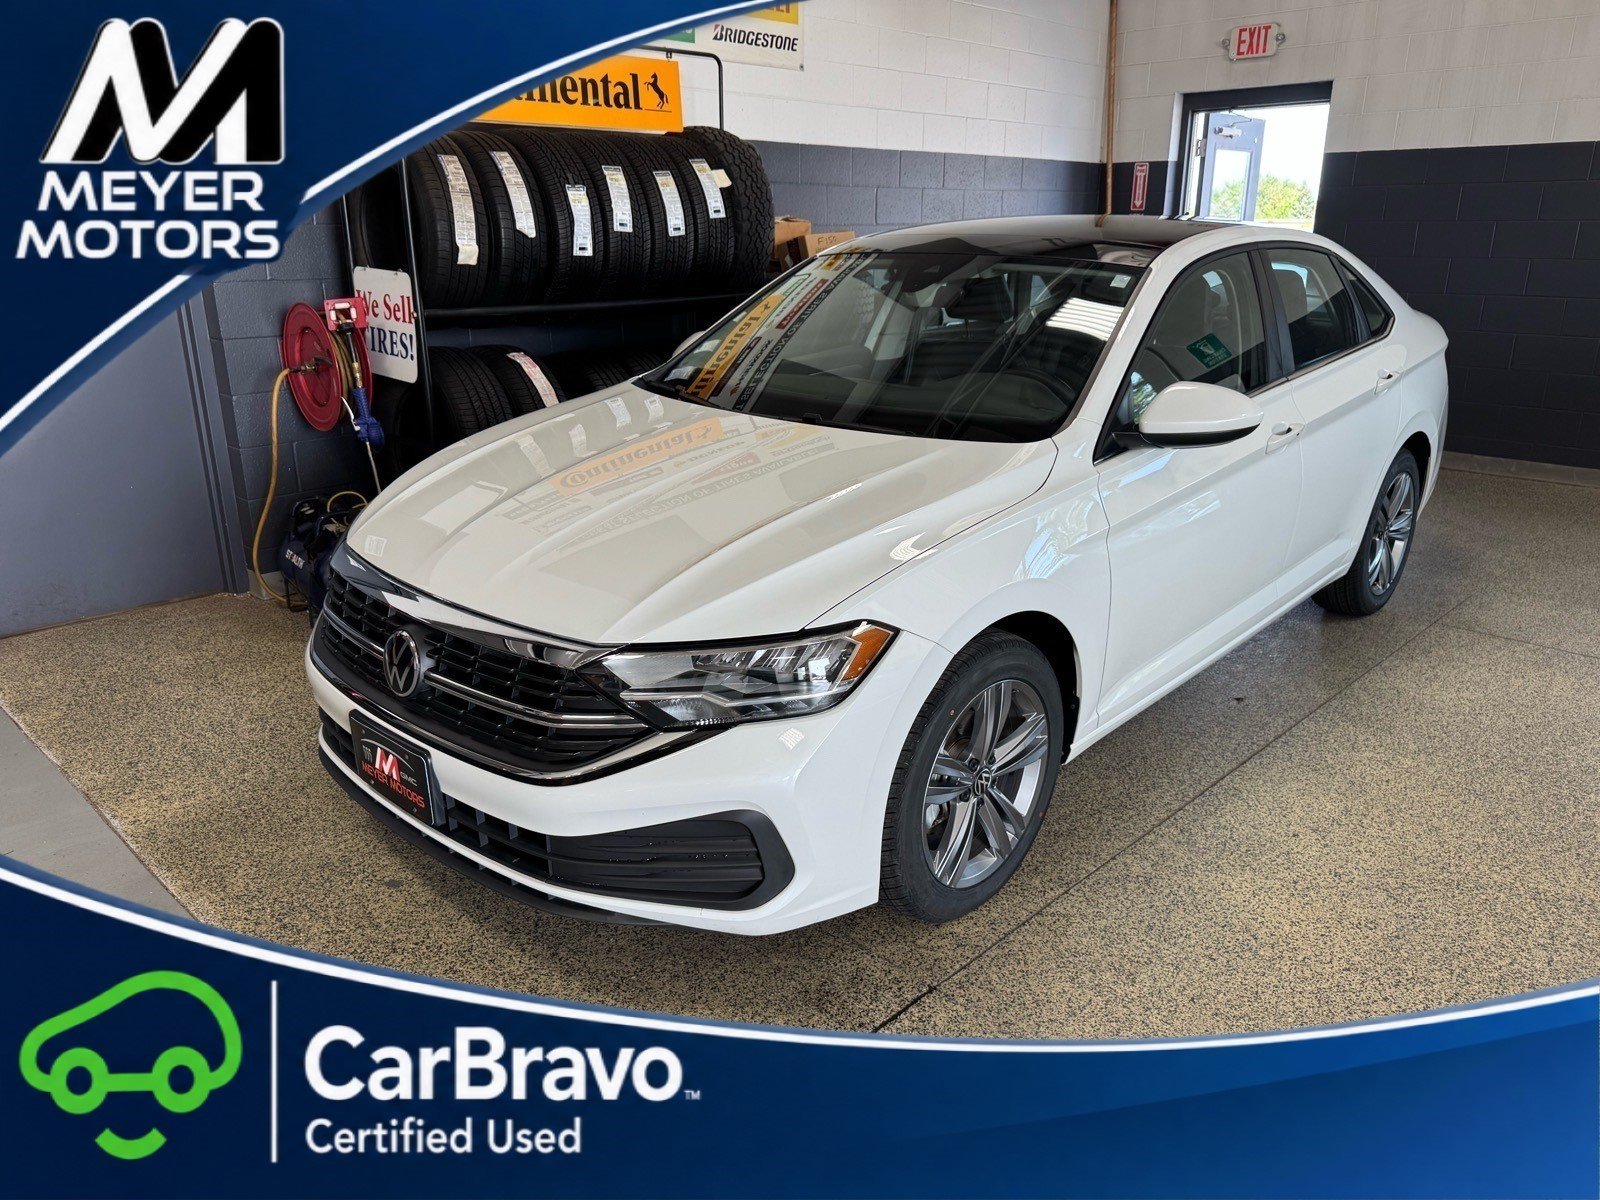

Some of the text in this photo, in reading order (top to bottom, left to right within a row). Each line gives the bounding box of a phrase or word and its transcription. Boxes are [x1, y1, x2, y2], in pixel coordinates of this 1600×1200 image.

[712, 24, 798, 51] BRIDGESTONE
[1236, 24, 1272, 56] EXIT
[513, 73, 642, 110] nental
[383, 294, 414, 325] Sell
[367, 325, 414, 361] IRES!
[361, 760, 425, 808] MEYER MOTORS
